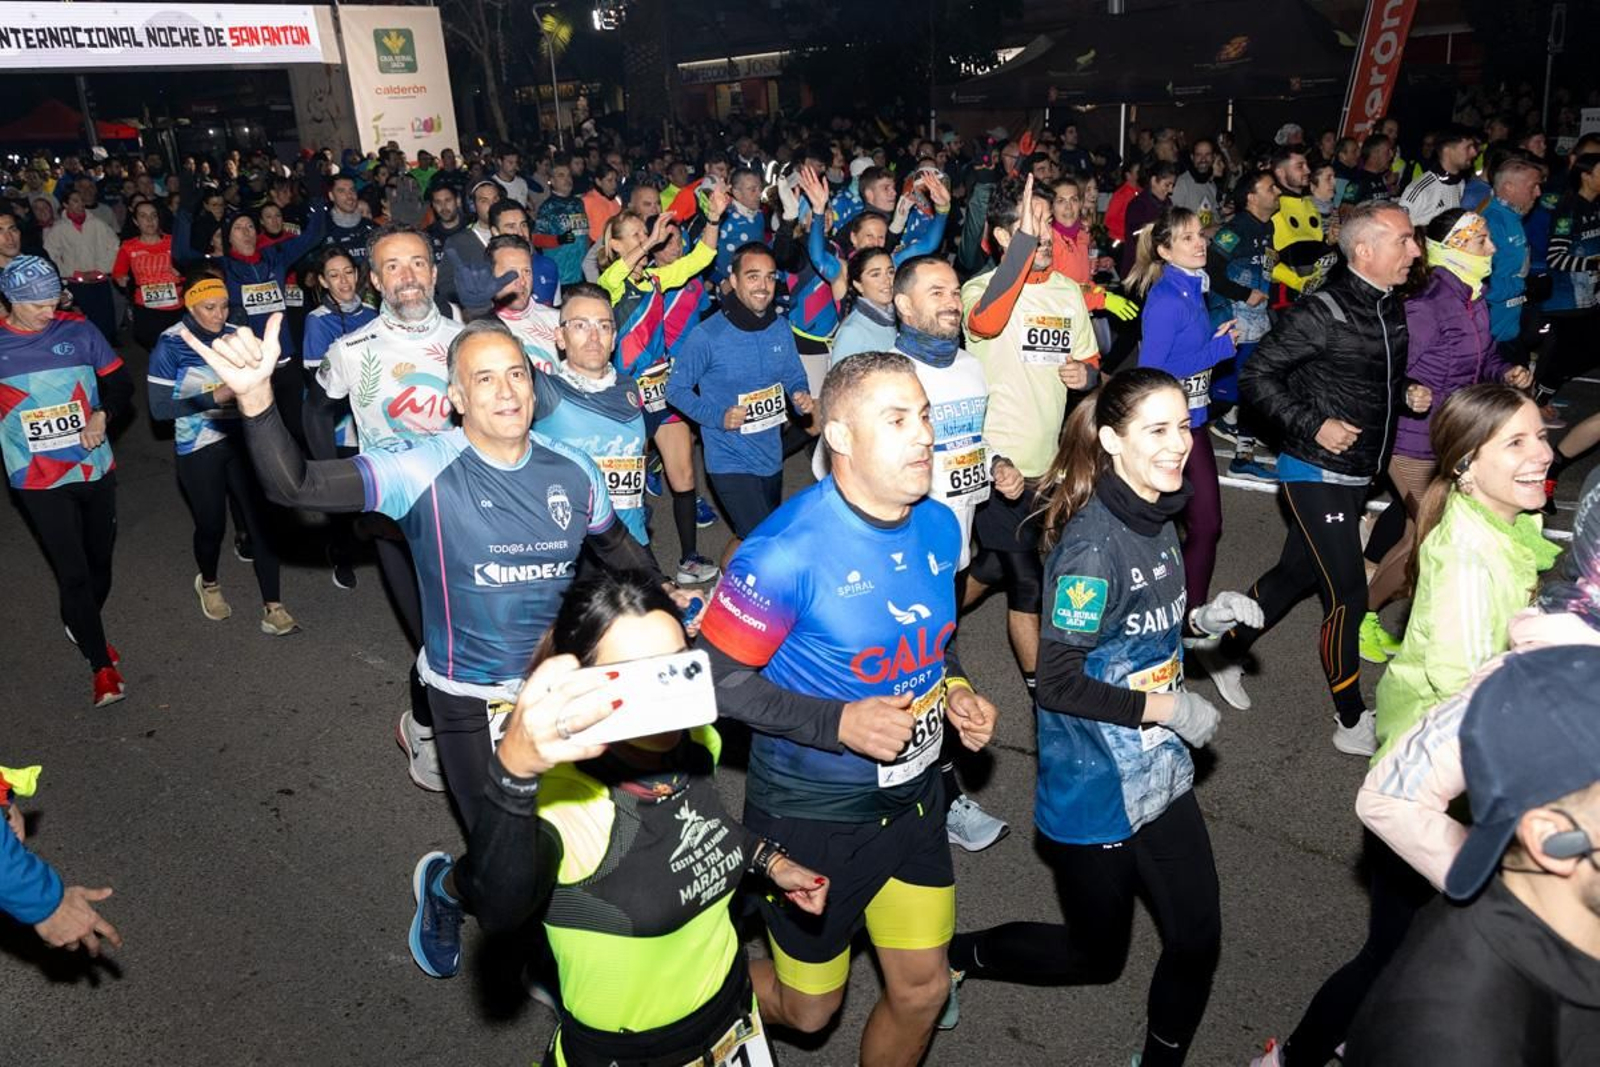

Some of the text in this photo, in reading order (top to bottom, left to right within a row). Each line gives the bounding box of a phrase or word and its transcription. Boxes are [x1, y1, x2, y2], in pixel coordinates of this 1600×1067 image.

[149, 27, 201, 48] NOCHE
[203, 26, 227, 47] DE
[145, 289, 174, 300] 5371
[247, 289, 279, 304] 4831
[1027, 328, 1070, 347] 6096
[746, 395, 782, 417] 4605
[29, 414, 81, 436] 5108
[603, 471, 642, 489] 946
[950, 463, 986, 489] 6553
[526, 543, 533, 551] A
[535, 540, 568, 551] CORRER
[837, 581, 875, 596] SPIRAL
[1125, 606, 1169, 636] SAN
[894, 669, 932, 696] SPORT
[671, 854, 695, 873] COSTA
[692, 847, 724, 877] ULTRA
[679, 846, 743, 905] MARATON
[700, 877, 727, 906] 2022
